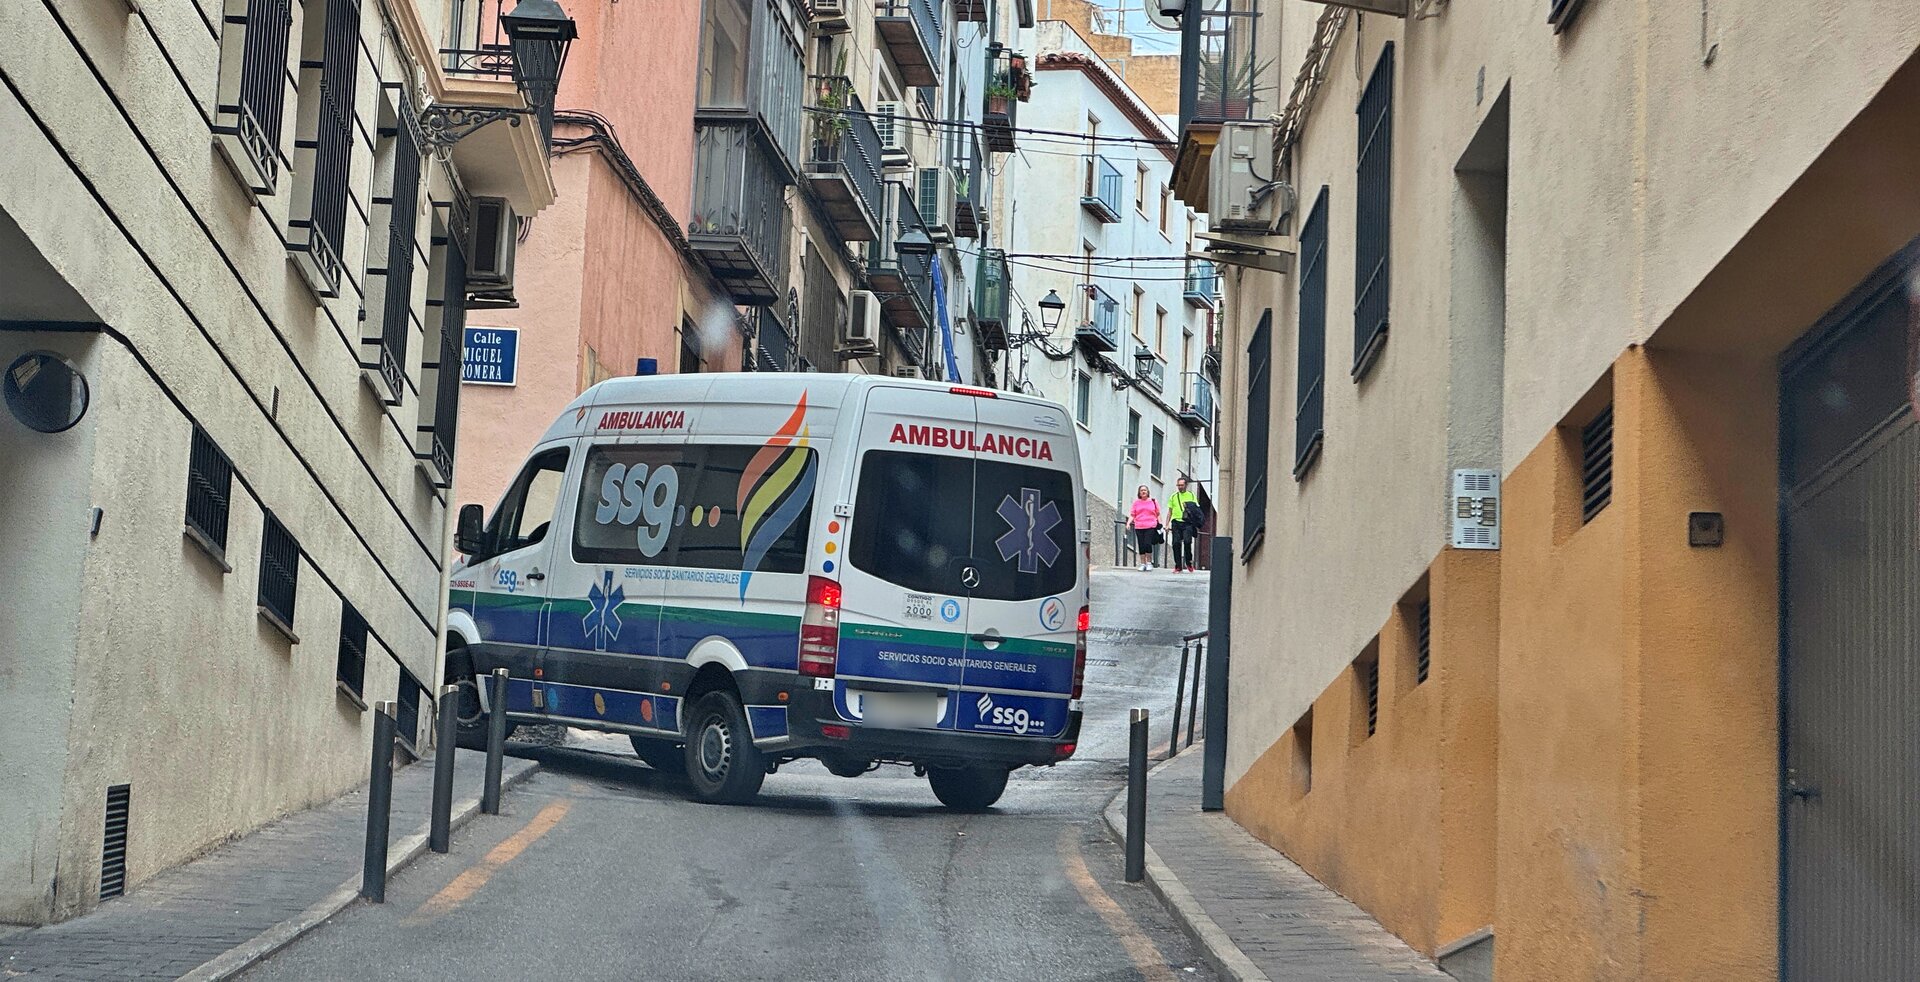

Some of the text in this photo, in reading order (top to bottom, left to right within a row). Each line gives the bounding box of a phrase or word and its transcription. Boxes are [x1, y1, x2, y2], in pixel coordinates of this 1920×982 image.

[473, 332, 502, 344] Calle
[463, 347, 502, 363] MIGUEL
[597, 410, 685, 430] AMBULANCIA
[889, 423, 1053, 462] AMBULANCIA
[624, 567, 740, 585] SERVICIOS SOCIO SANITARIOS GENERALES
[906, 605, 932, 616] 2000
[878, 650, 1037, 674] SERVICIOS SOCIO SANITARIOS GENERALES
